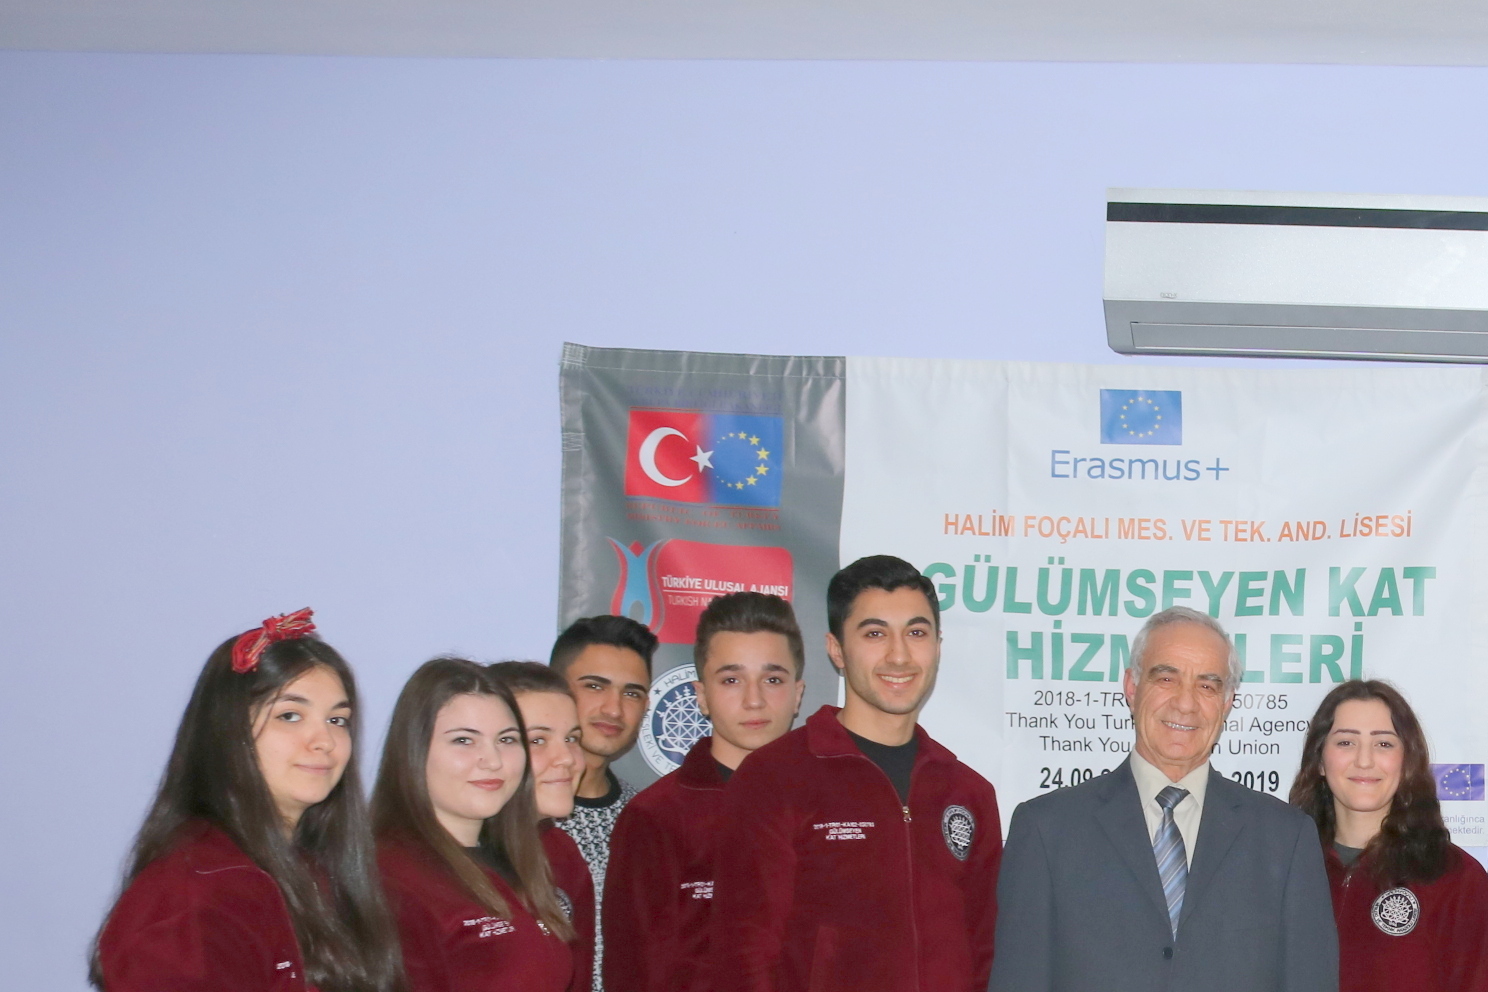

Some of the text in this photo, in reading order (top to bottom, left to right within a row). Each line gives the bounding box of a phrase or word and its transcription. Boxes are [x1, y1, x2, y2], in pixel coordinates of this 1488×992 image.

[1051, 449, 1230, 481] Erasmus+
[943, 509, 1412, 544] HALİM FOÇALI MES. VE TEK. AND. LİSESİ
[662, 575, 703, 589] TÜRKİYE
[922, 554, 1437, 619] GÜLÜMSEYEN KAT
[1006, 620, 1364, 684] HİZMLERİ
[1005, 712, 1058, 729] Thank
[1064, 713, 1096, 730] You
[1039, 735, 1093, 752] Thank
[1098, 736, 1131, 753] You
[1229, 739, 1280, 755] Union
